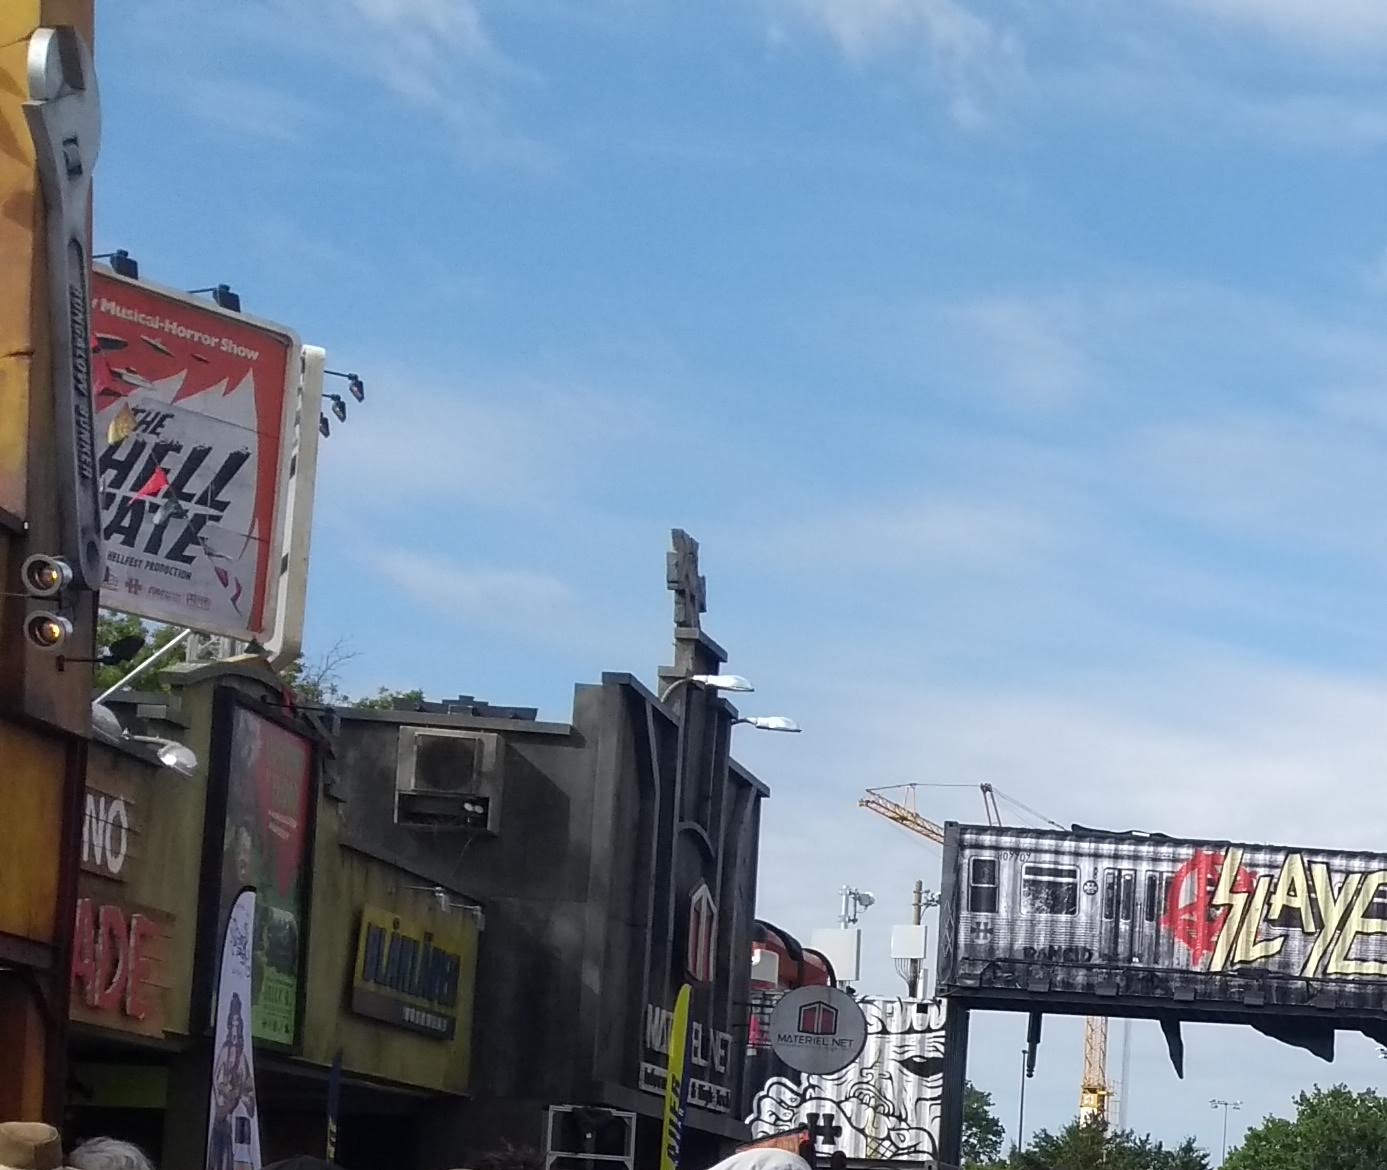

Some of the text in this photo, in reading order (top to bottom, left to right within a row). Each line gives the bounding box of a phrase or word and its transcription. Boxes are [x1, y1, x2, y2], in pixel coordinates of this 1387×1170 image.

[101, 297, 260, 362] Musical-Horror Show
[132, 407, 174, 437] THE
[99, 438, 251, 512] HELL
[102, 493, 224, 566] ATE
[107, 551, 192, 581] HELLFEST PRODUCTION
